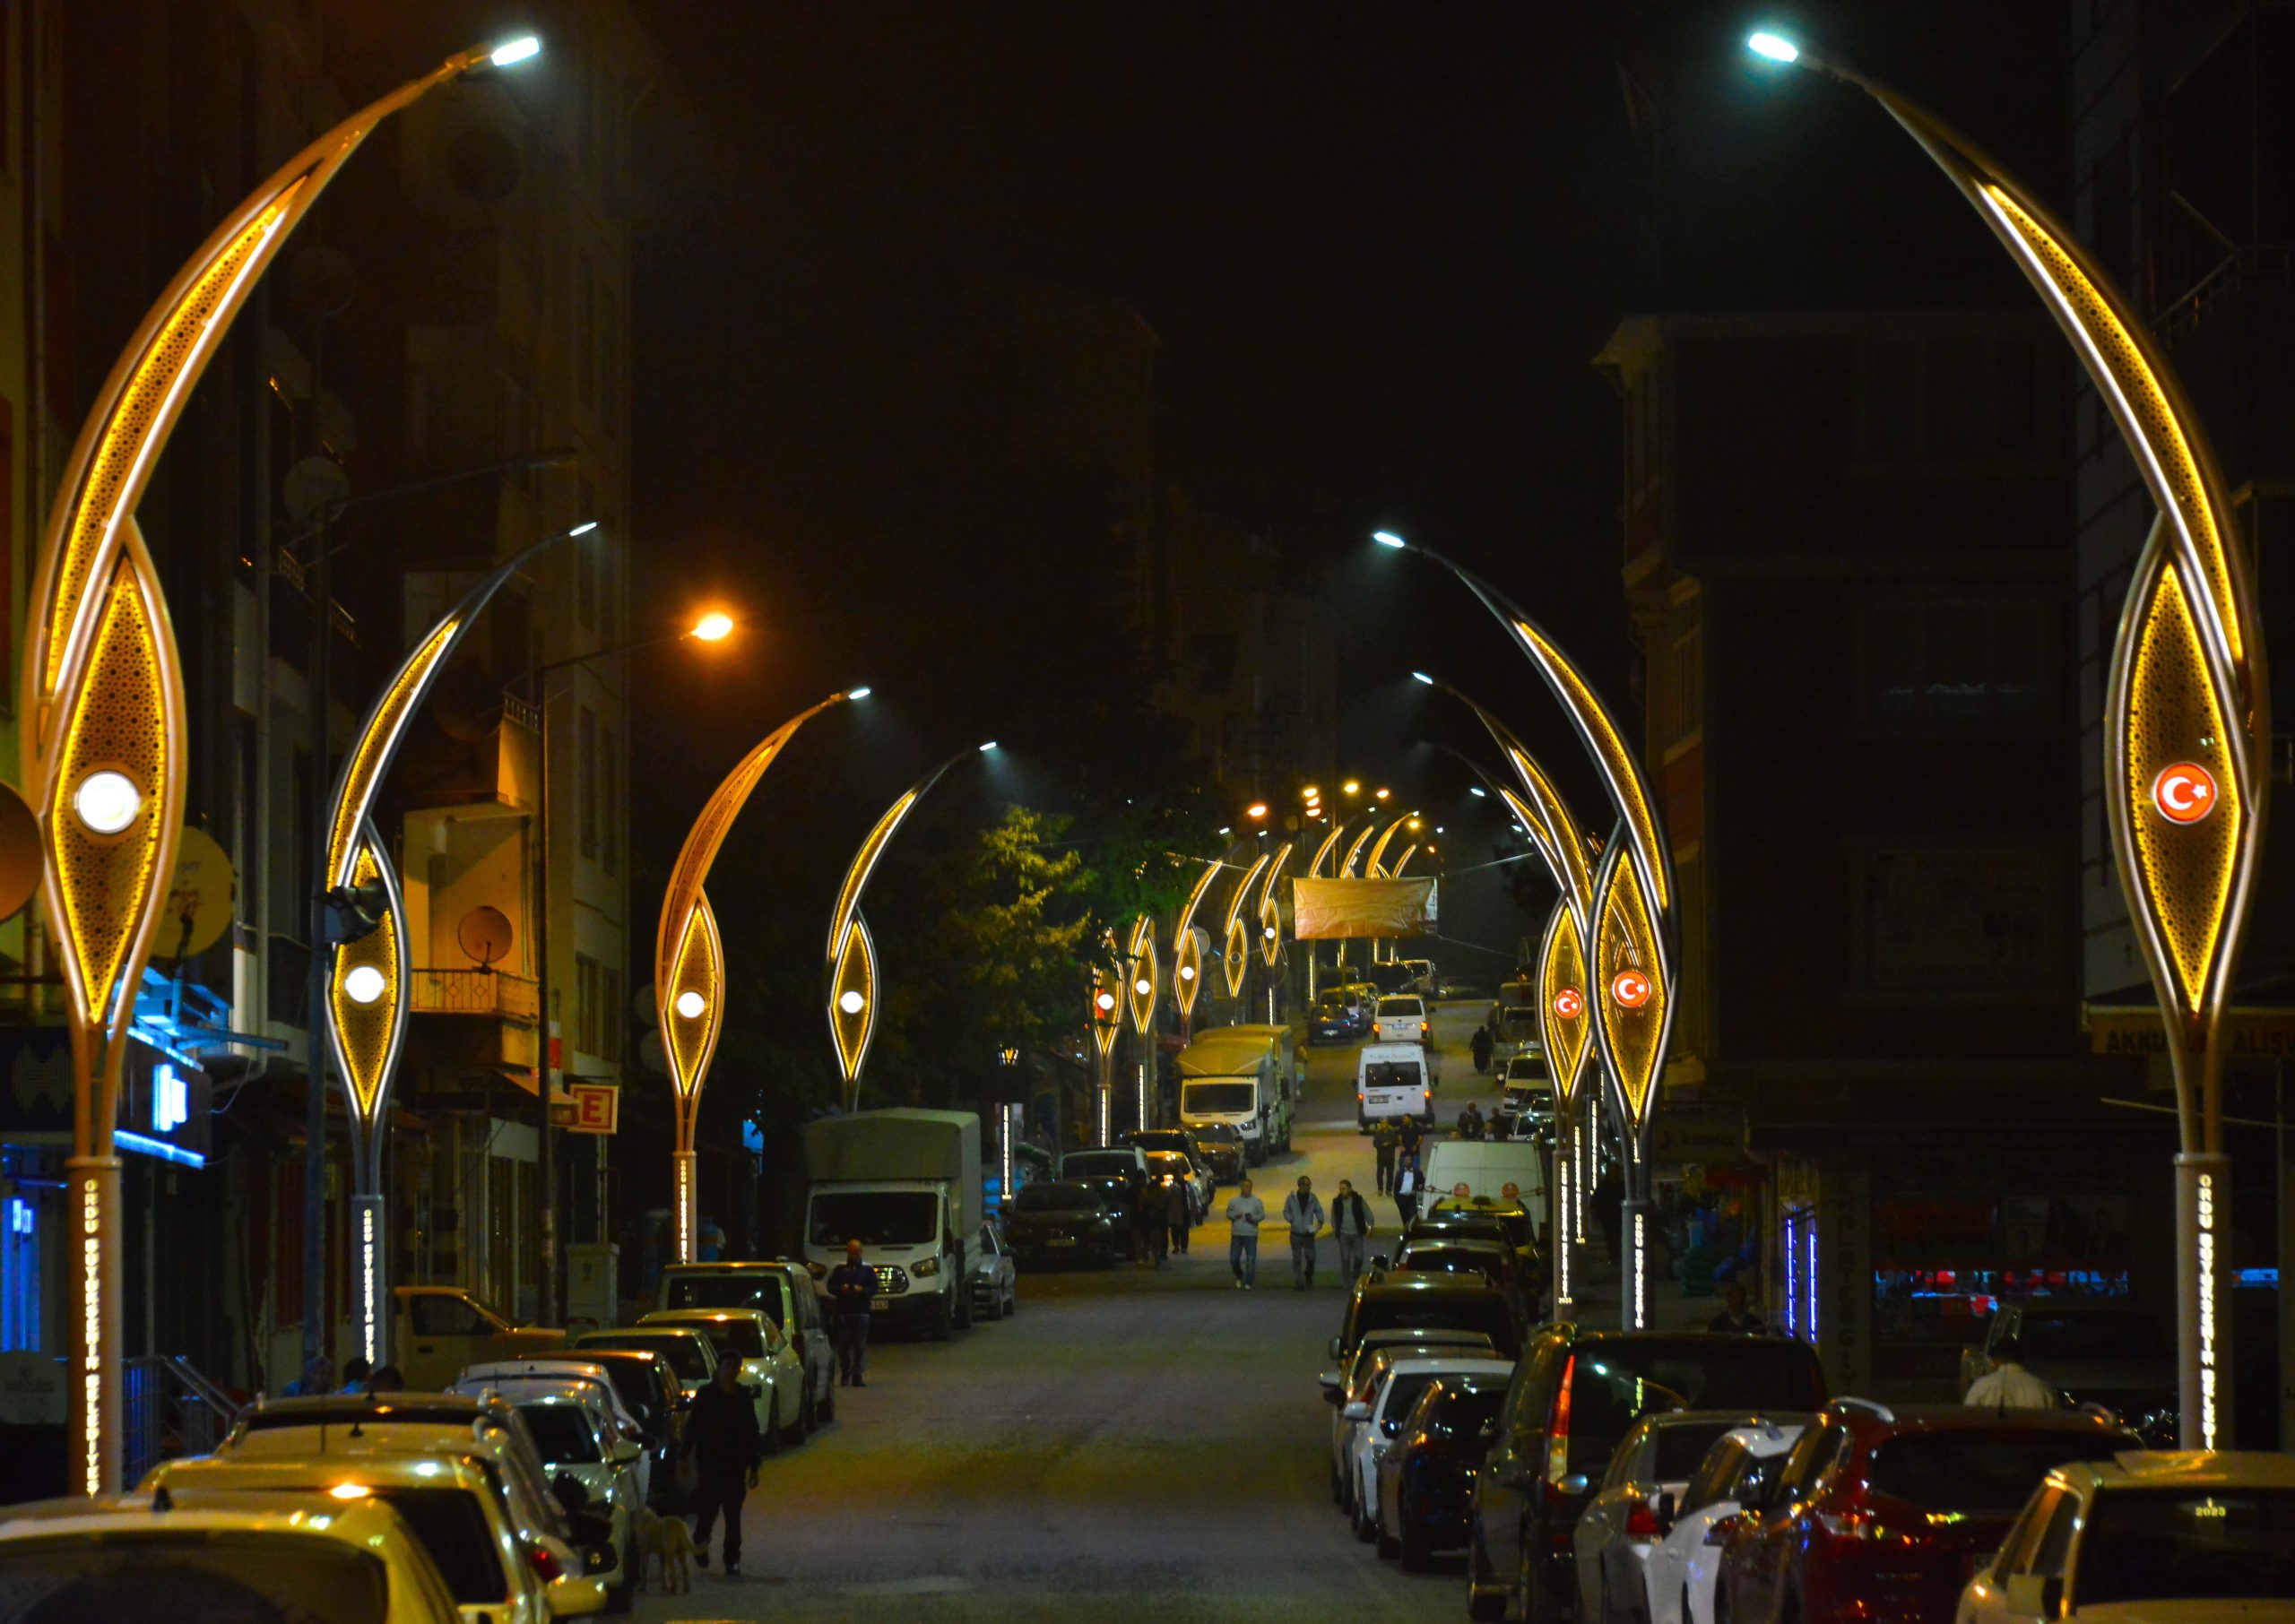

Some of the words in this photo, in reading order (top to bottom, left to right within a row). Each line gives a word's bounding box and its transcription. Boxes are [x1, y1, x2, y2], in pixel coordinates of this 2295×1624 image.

[583, 1094, 603, 1123] E
[84, 1179, 100, 1232] ORDU
[2199, 1174, 2213, 1229] ORDU
